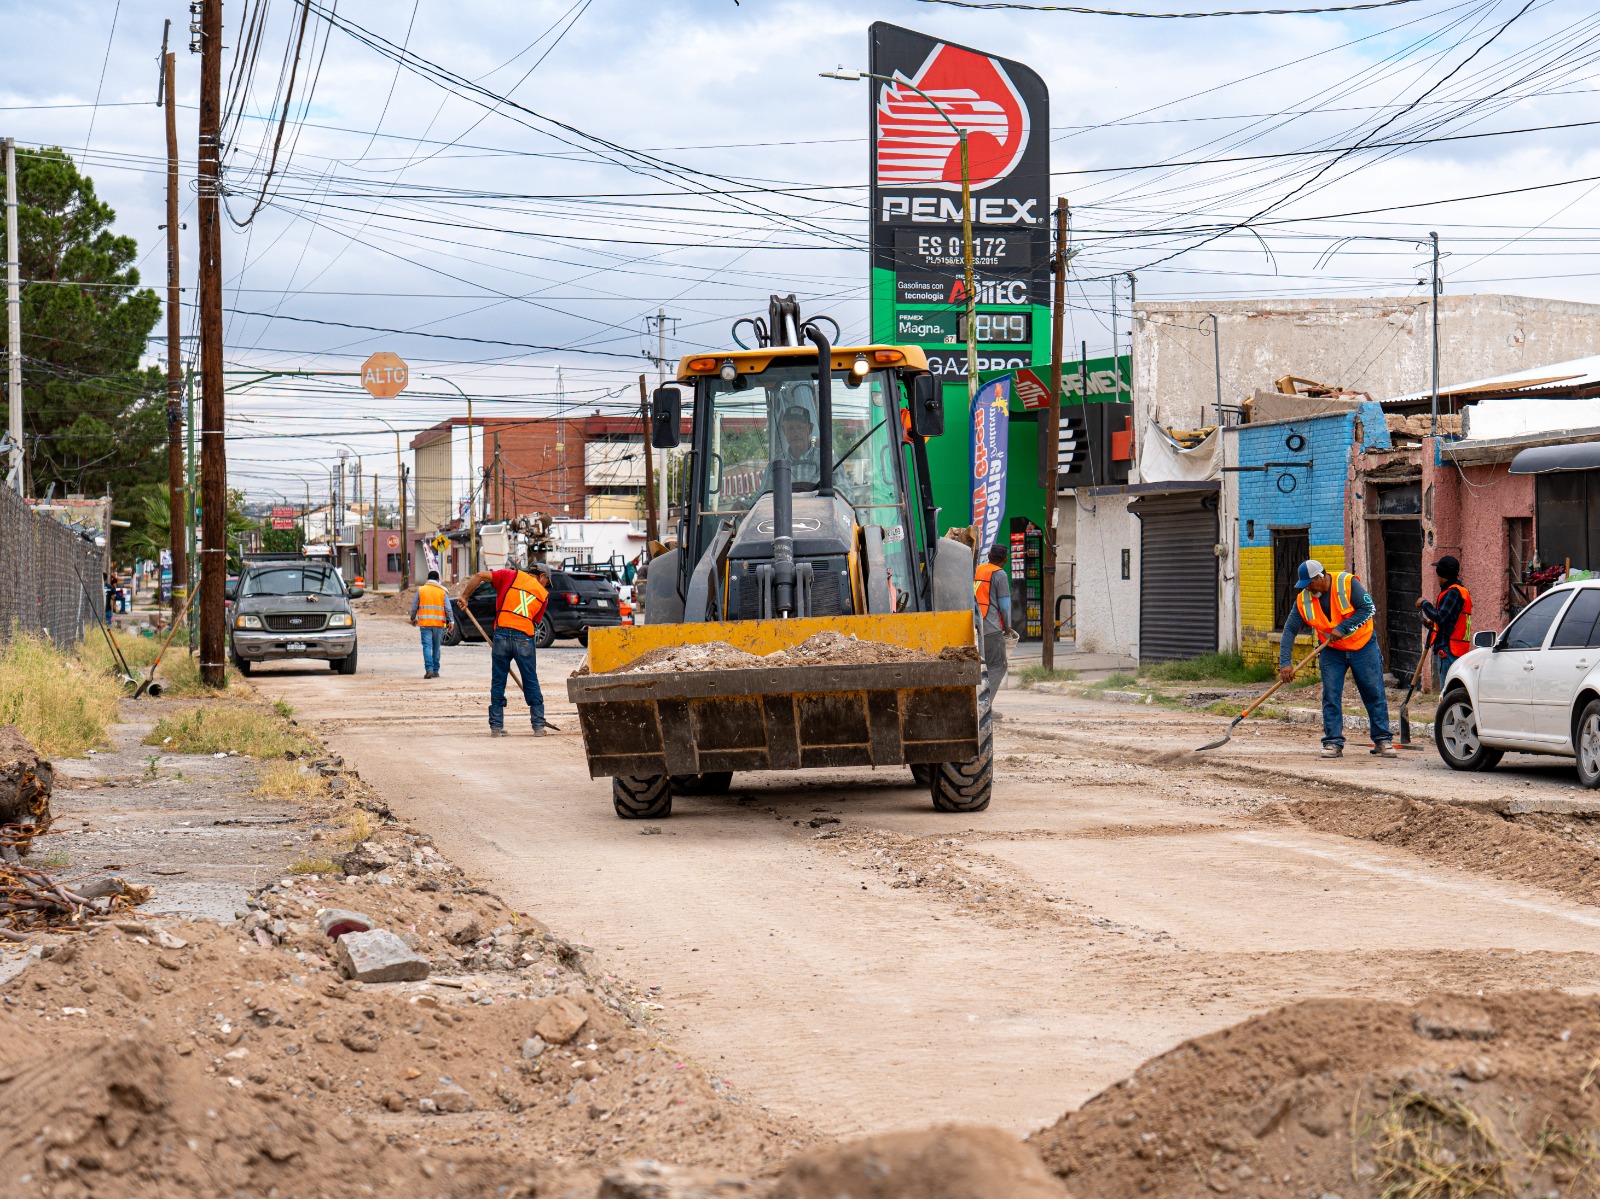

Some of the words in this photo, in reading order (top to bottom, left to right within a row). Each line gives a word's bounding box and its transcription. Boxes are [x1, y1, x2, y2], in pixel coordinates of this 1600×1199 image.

[882, 196, 1037, 224] PEMEX
[918, 235, 943, 257] ES
[948, 236, 1007, 257] 0172
[897, 281, 931, 290] Gasolinas
[898, 321, 941, 337] Magna
[364, 366, 406, 384] ALTO
[1060, 368, 1132, 397] PEMEX
